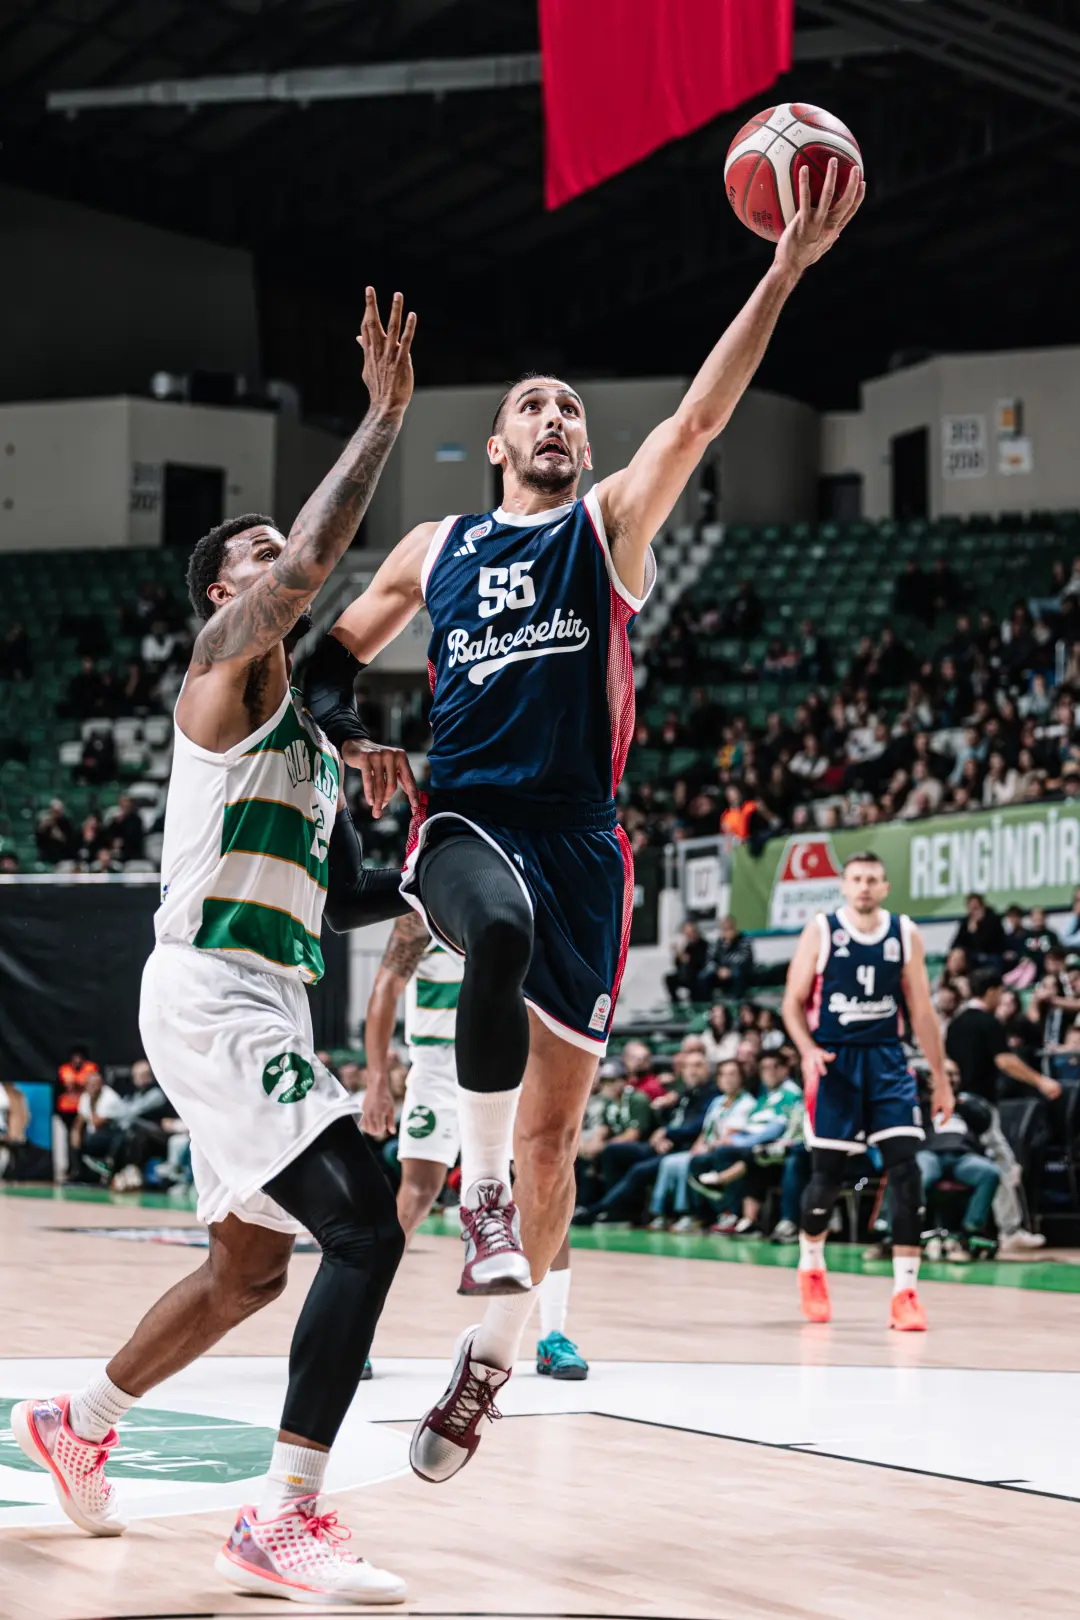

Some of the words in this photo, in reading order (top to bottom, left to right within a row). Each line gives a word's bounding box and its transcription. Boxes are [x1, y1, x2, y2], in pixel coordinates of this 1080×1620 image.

[478, 560, 536, 619] 55
[447, 608, 590, 671] Bahçeşehir
[856, 965, 875, 996] 4
